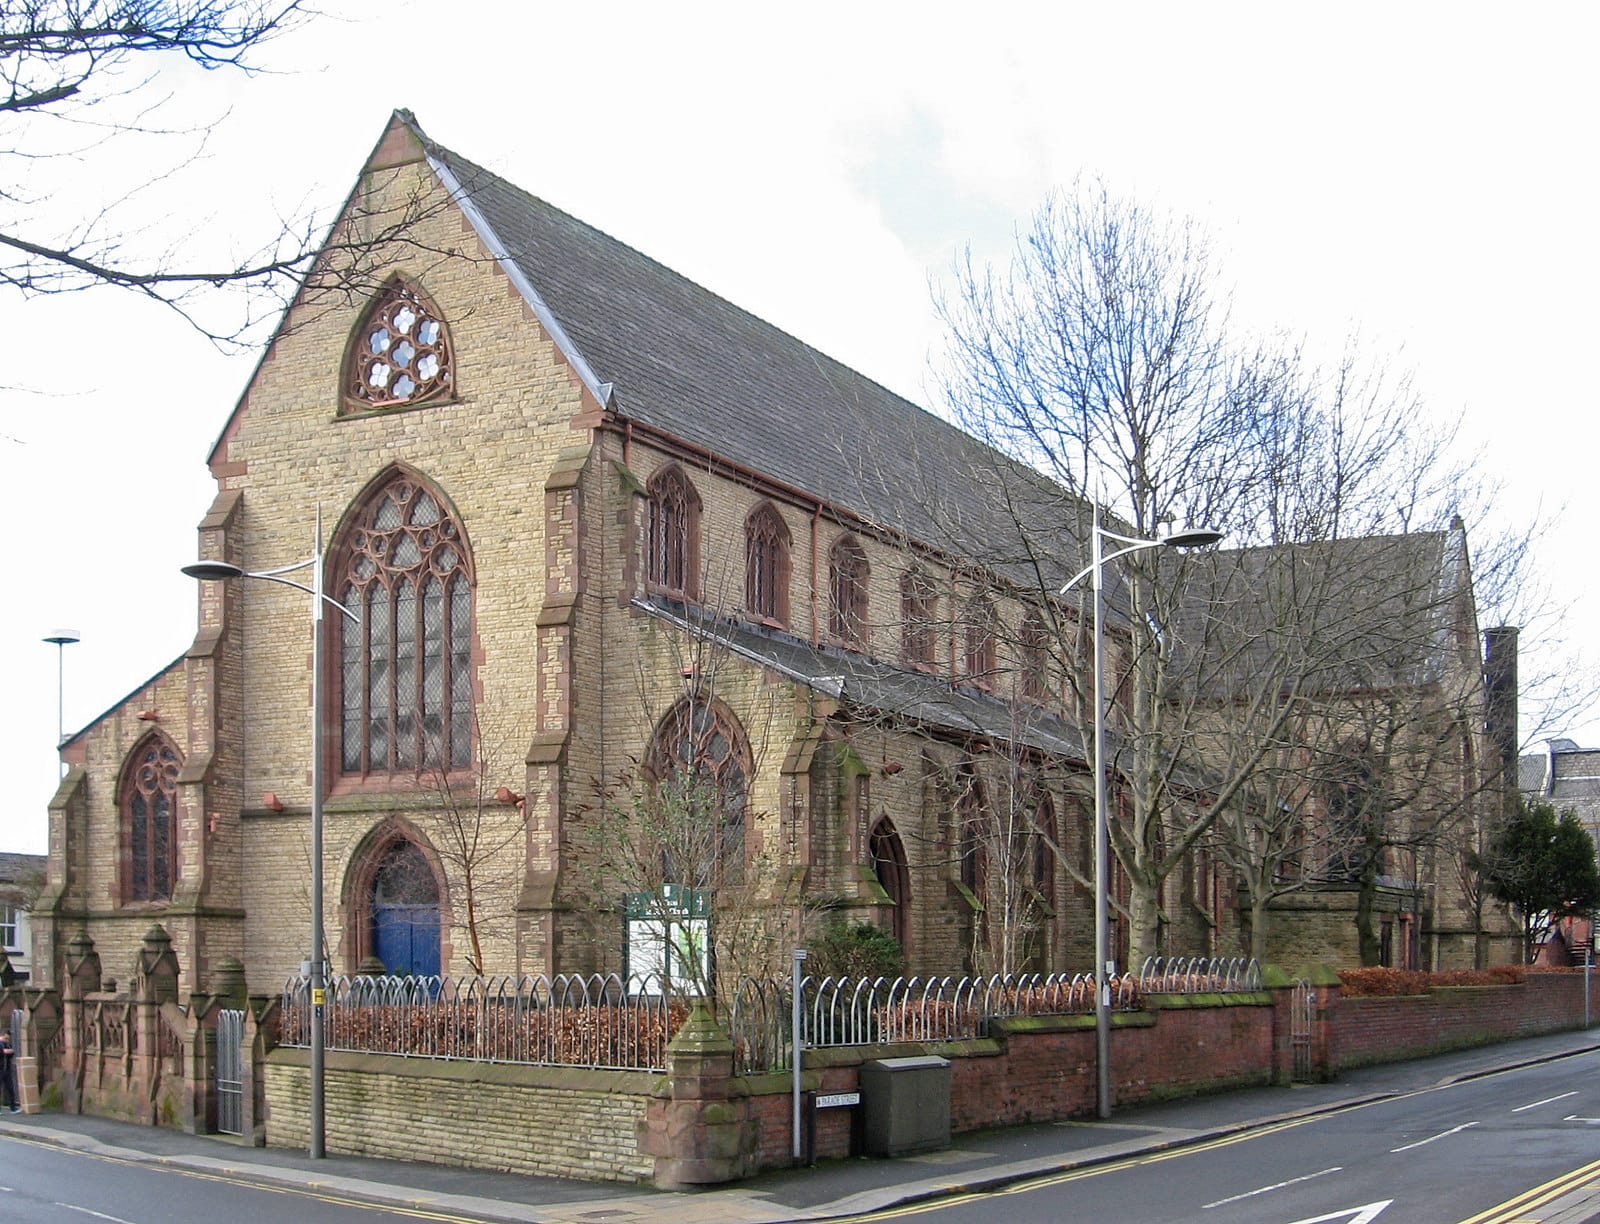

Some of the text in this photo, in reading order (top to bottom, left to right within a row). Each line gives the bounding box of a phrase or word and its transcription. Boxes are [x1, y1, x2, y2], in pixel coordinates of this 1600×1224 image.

[315, 991, 324, 1002] H
[821, 1094, 857, 1105] PARADE STREET
